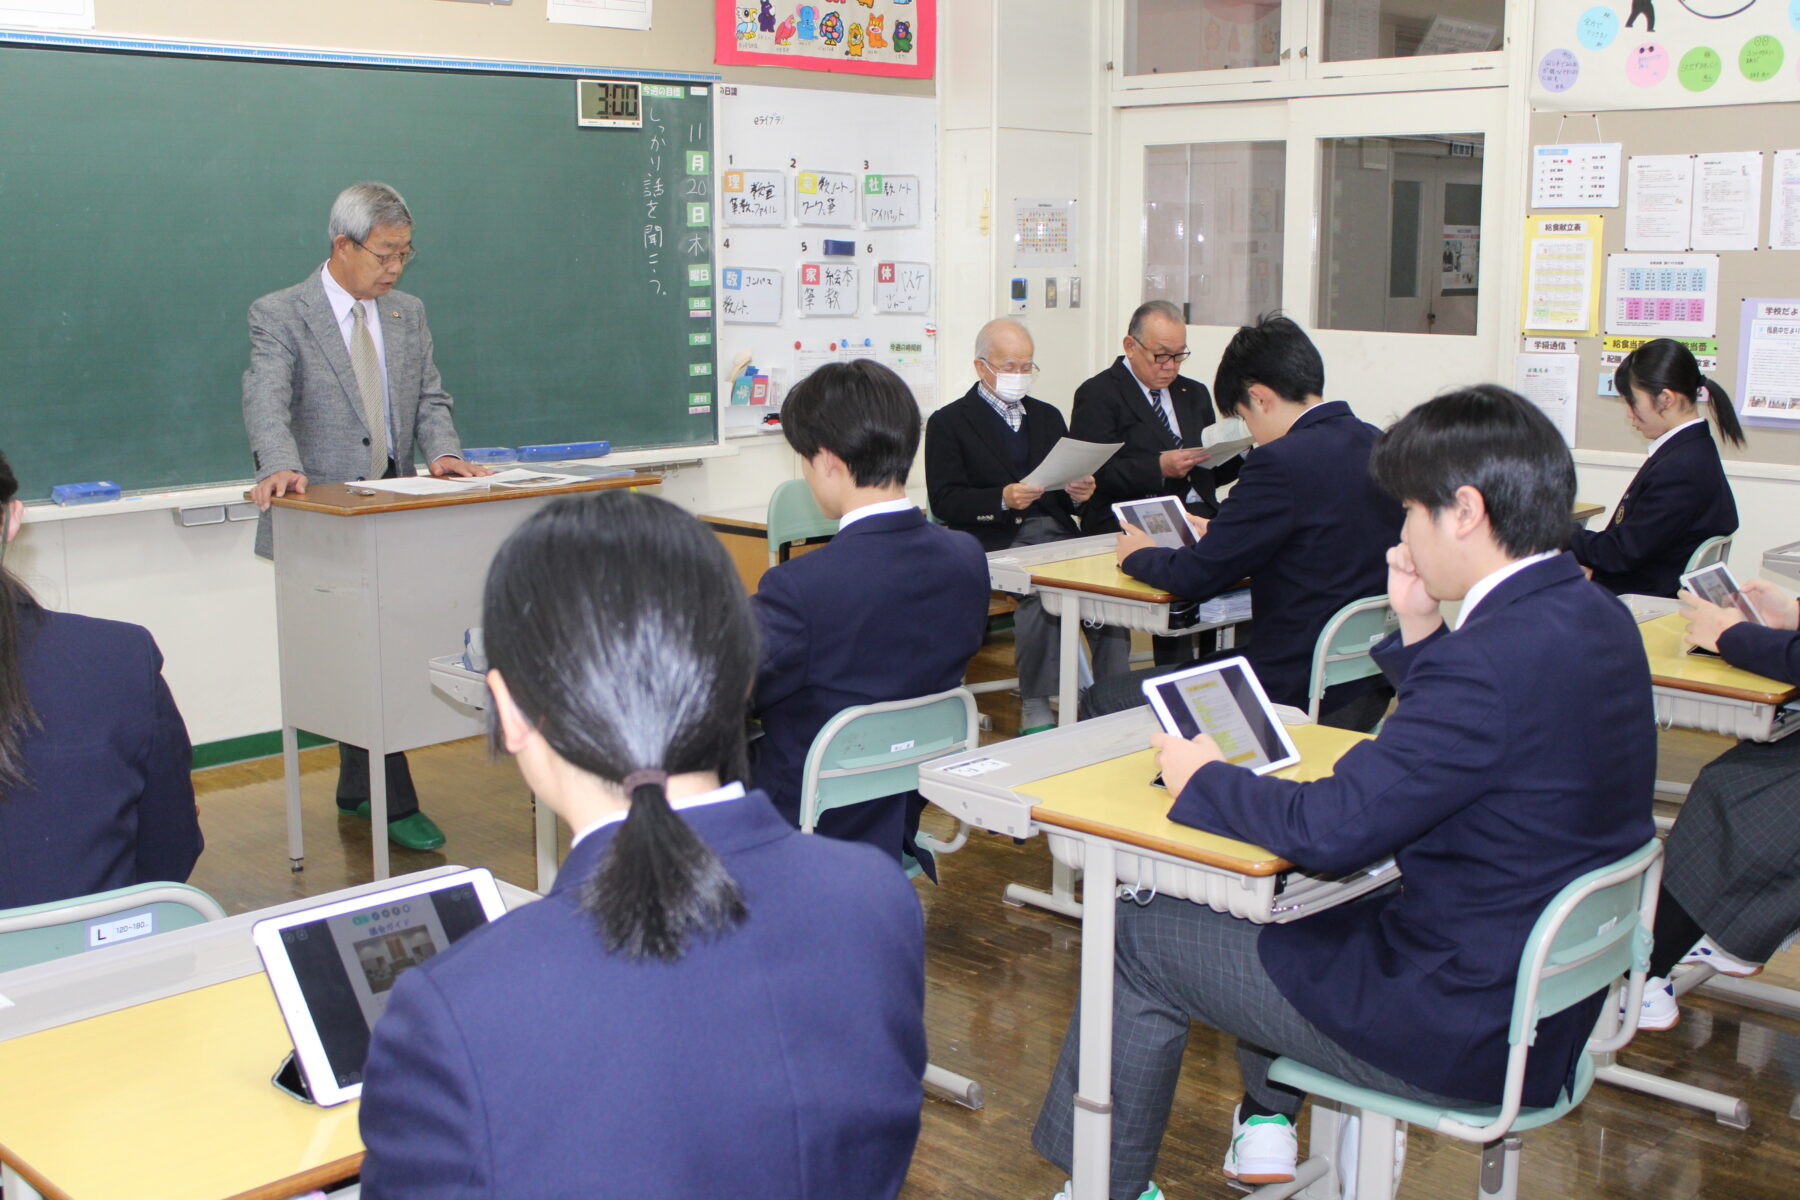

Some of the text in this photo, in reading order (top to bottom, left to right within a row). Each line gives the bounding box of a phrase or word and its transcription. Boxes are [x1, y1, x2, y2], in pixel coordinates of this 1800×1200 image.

[597, 83, 638, 116] 3:00
[689, 122, 702, 142] 11
[692, 154, 704, 172] 月
[728, 155, 733, 165] 1
[790, 158, 797, 168] 2
[863, 160, 870, 170] 3
[686, 178, 706, 196] 20
[727, 174, 740, 189] 理
[869, 177, 880, 192] 社
[643, 105, 667, 295] しっかり話を聞こう。
[692, 206, 705, 223] 日
[1545, 223, 1581, 232] 給食献立表
[687, 233, 704, 256] 木
[724, 239, 730, 248] 4
[801, 242, 808, 251] 5
[867, 244, 873, 253] 6
[806, 267, 817, 282] 家
[825, 266, 853, 287] 絵本
[881, 266, 892, 280] 体
[1682, 342, 1707, 351] 当番
[97, 929, 107, 941] L
